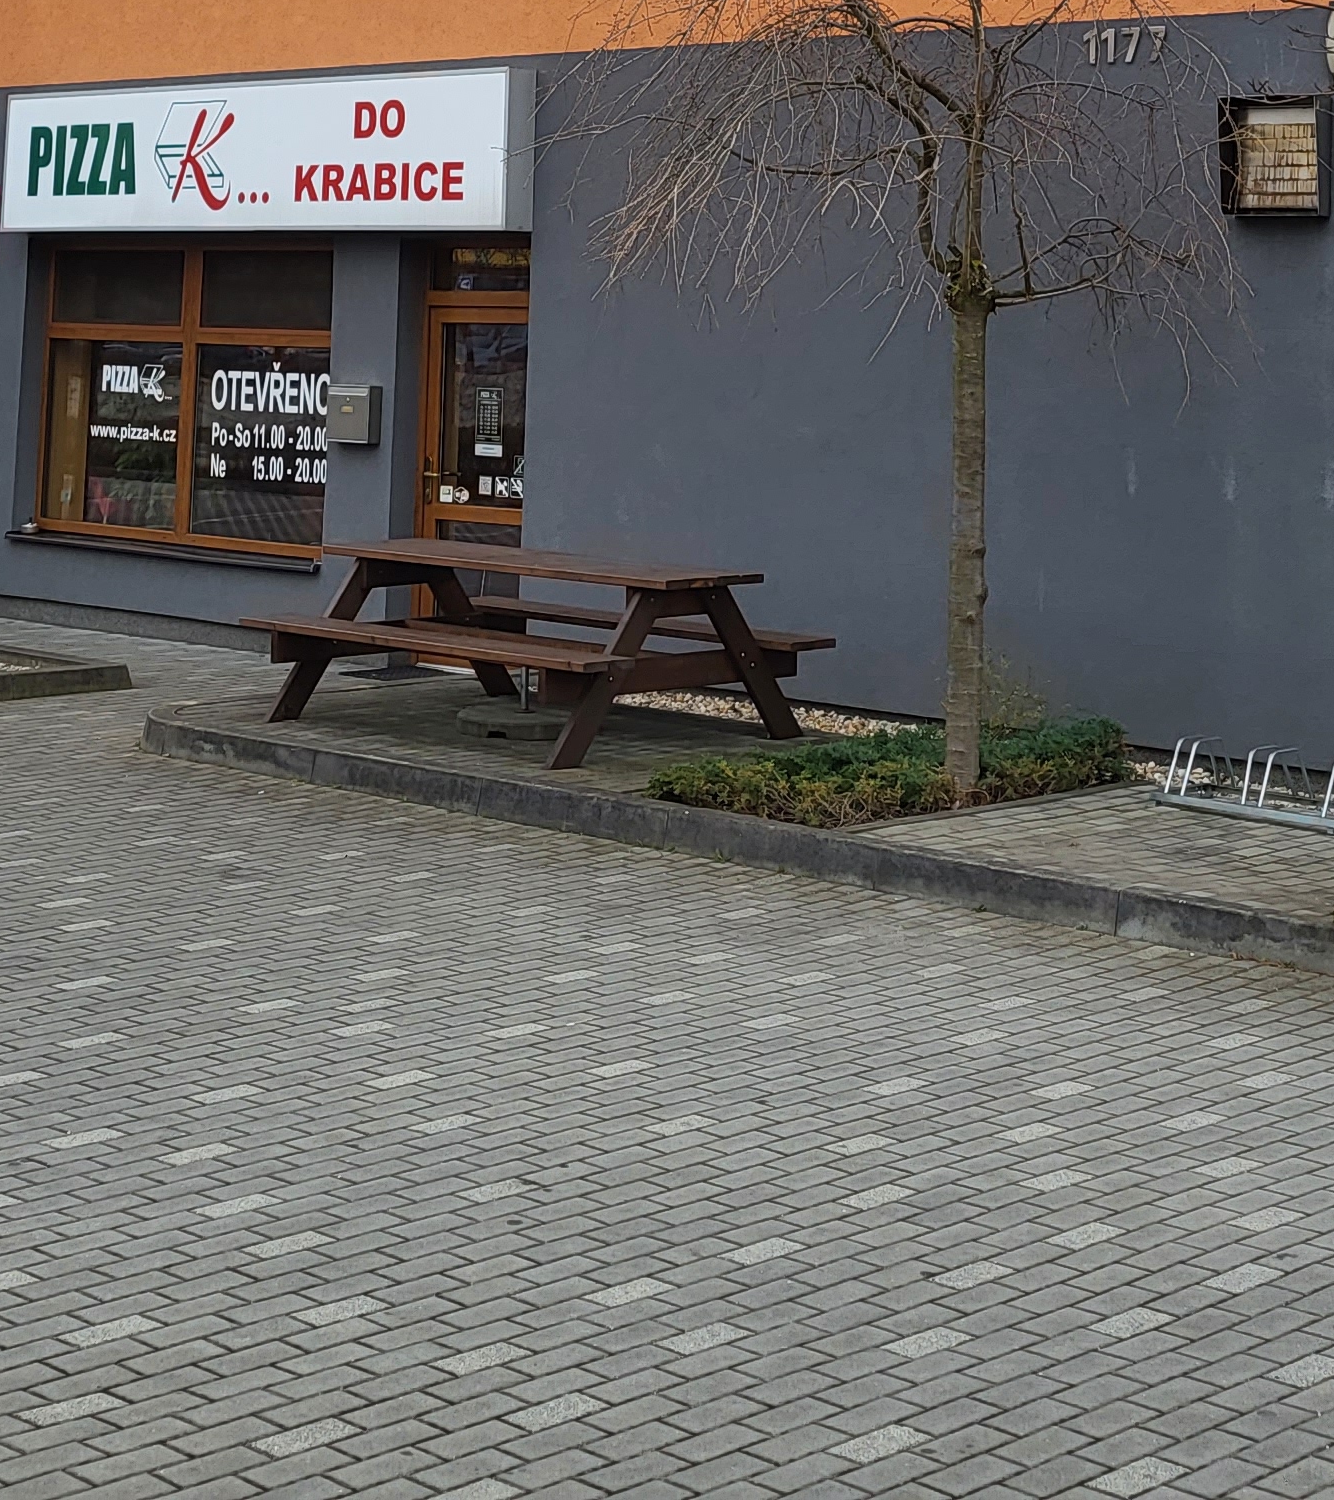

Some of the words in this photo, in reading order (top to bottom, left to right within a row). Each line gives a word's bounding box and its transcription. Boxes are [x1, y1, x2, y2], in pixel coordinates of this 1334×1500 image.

[1083, 25, 1166, 65] 1177
[353, 99, 406, 139] DO
[27, 122, 136, 197] PIZZA
[294, 161, 465, 202] KRABICE
[101, 364, 138, 394] PIZZA
[211, 362, 331, 416] OTEVŘENO
[90, 423, 176, 442] www.pizza-k.cz
[252, 424, 285, 450] 11.00
[295, 425, 328, 452] 20.00
[210, 453, 226, 478] Ne
[252, 455, 284, 481] 15.00
[294, 457, 327, 484] 20.00
